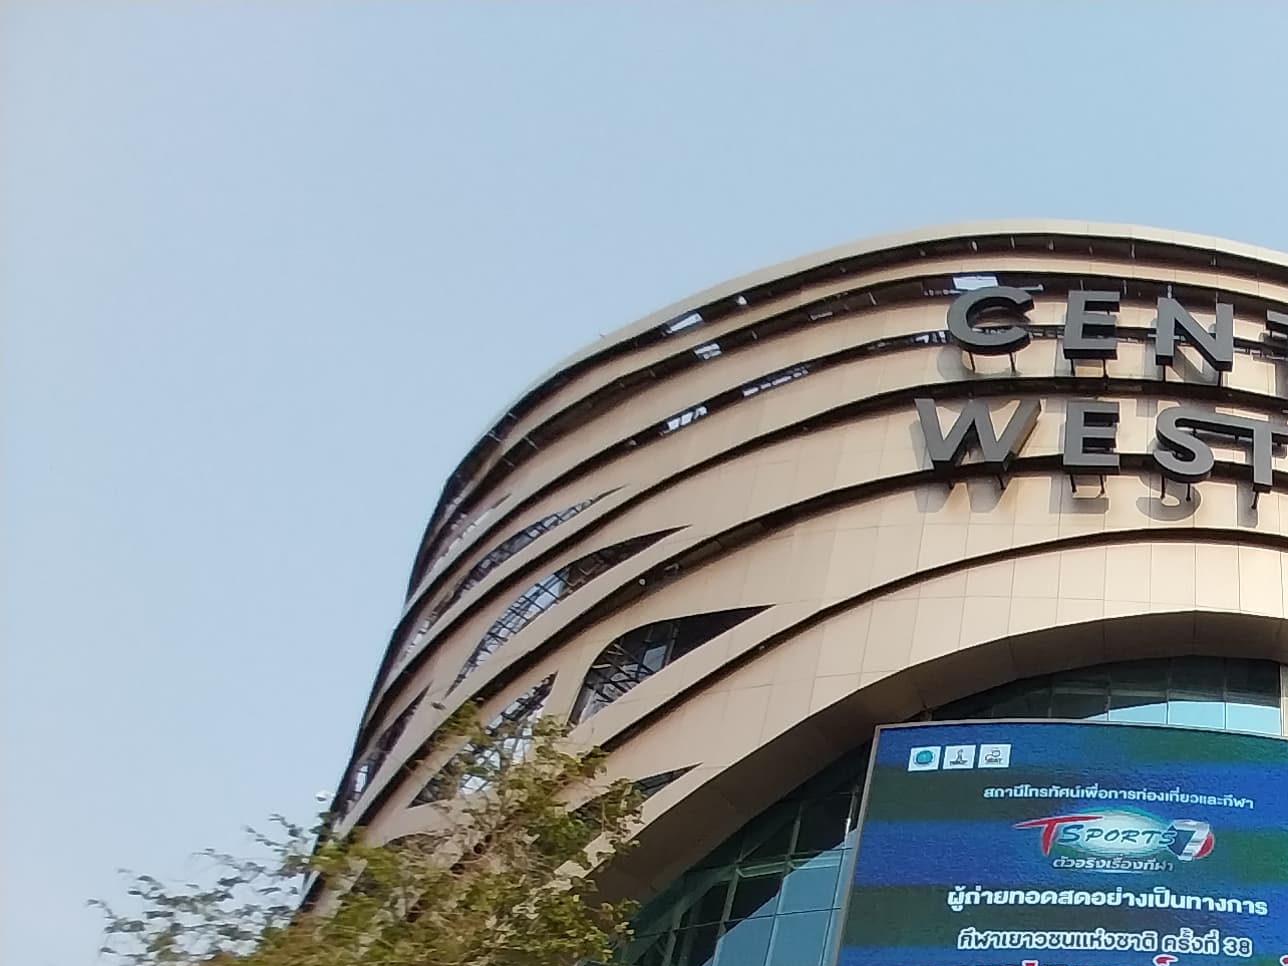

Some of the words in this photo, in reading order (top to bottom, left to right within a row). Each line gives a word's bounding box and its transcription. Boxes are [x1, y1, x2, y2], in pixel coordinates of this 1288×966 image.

[947, 885, 1268, 915] ผู้ถ่ายทอดสดอย่างเป็นทางการ
[1162, 927, 1220, 954] ครั้งที่
[1222, 938, 1253, 957] 38
